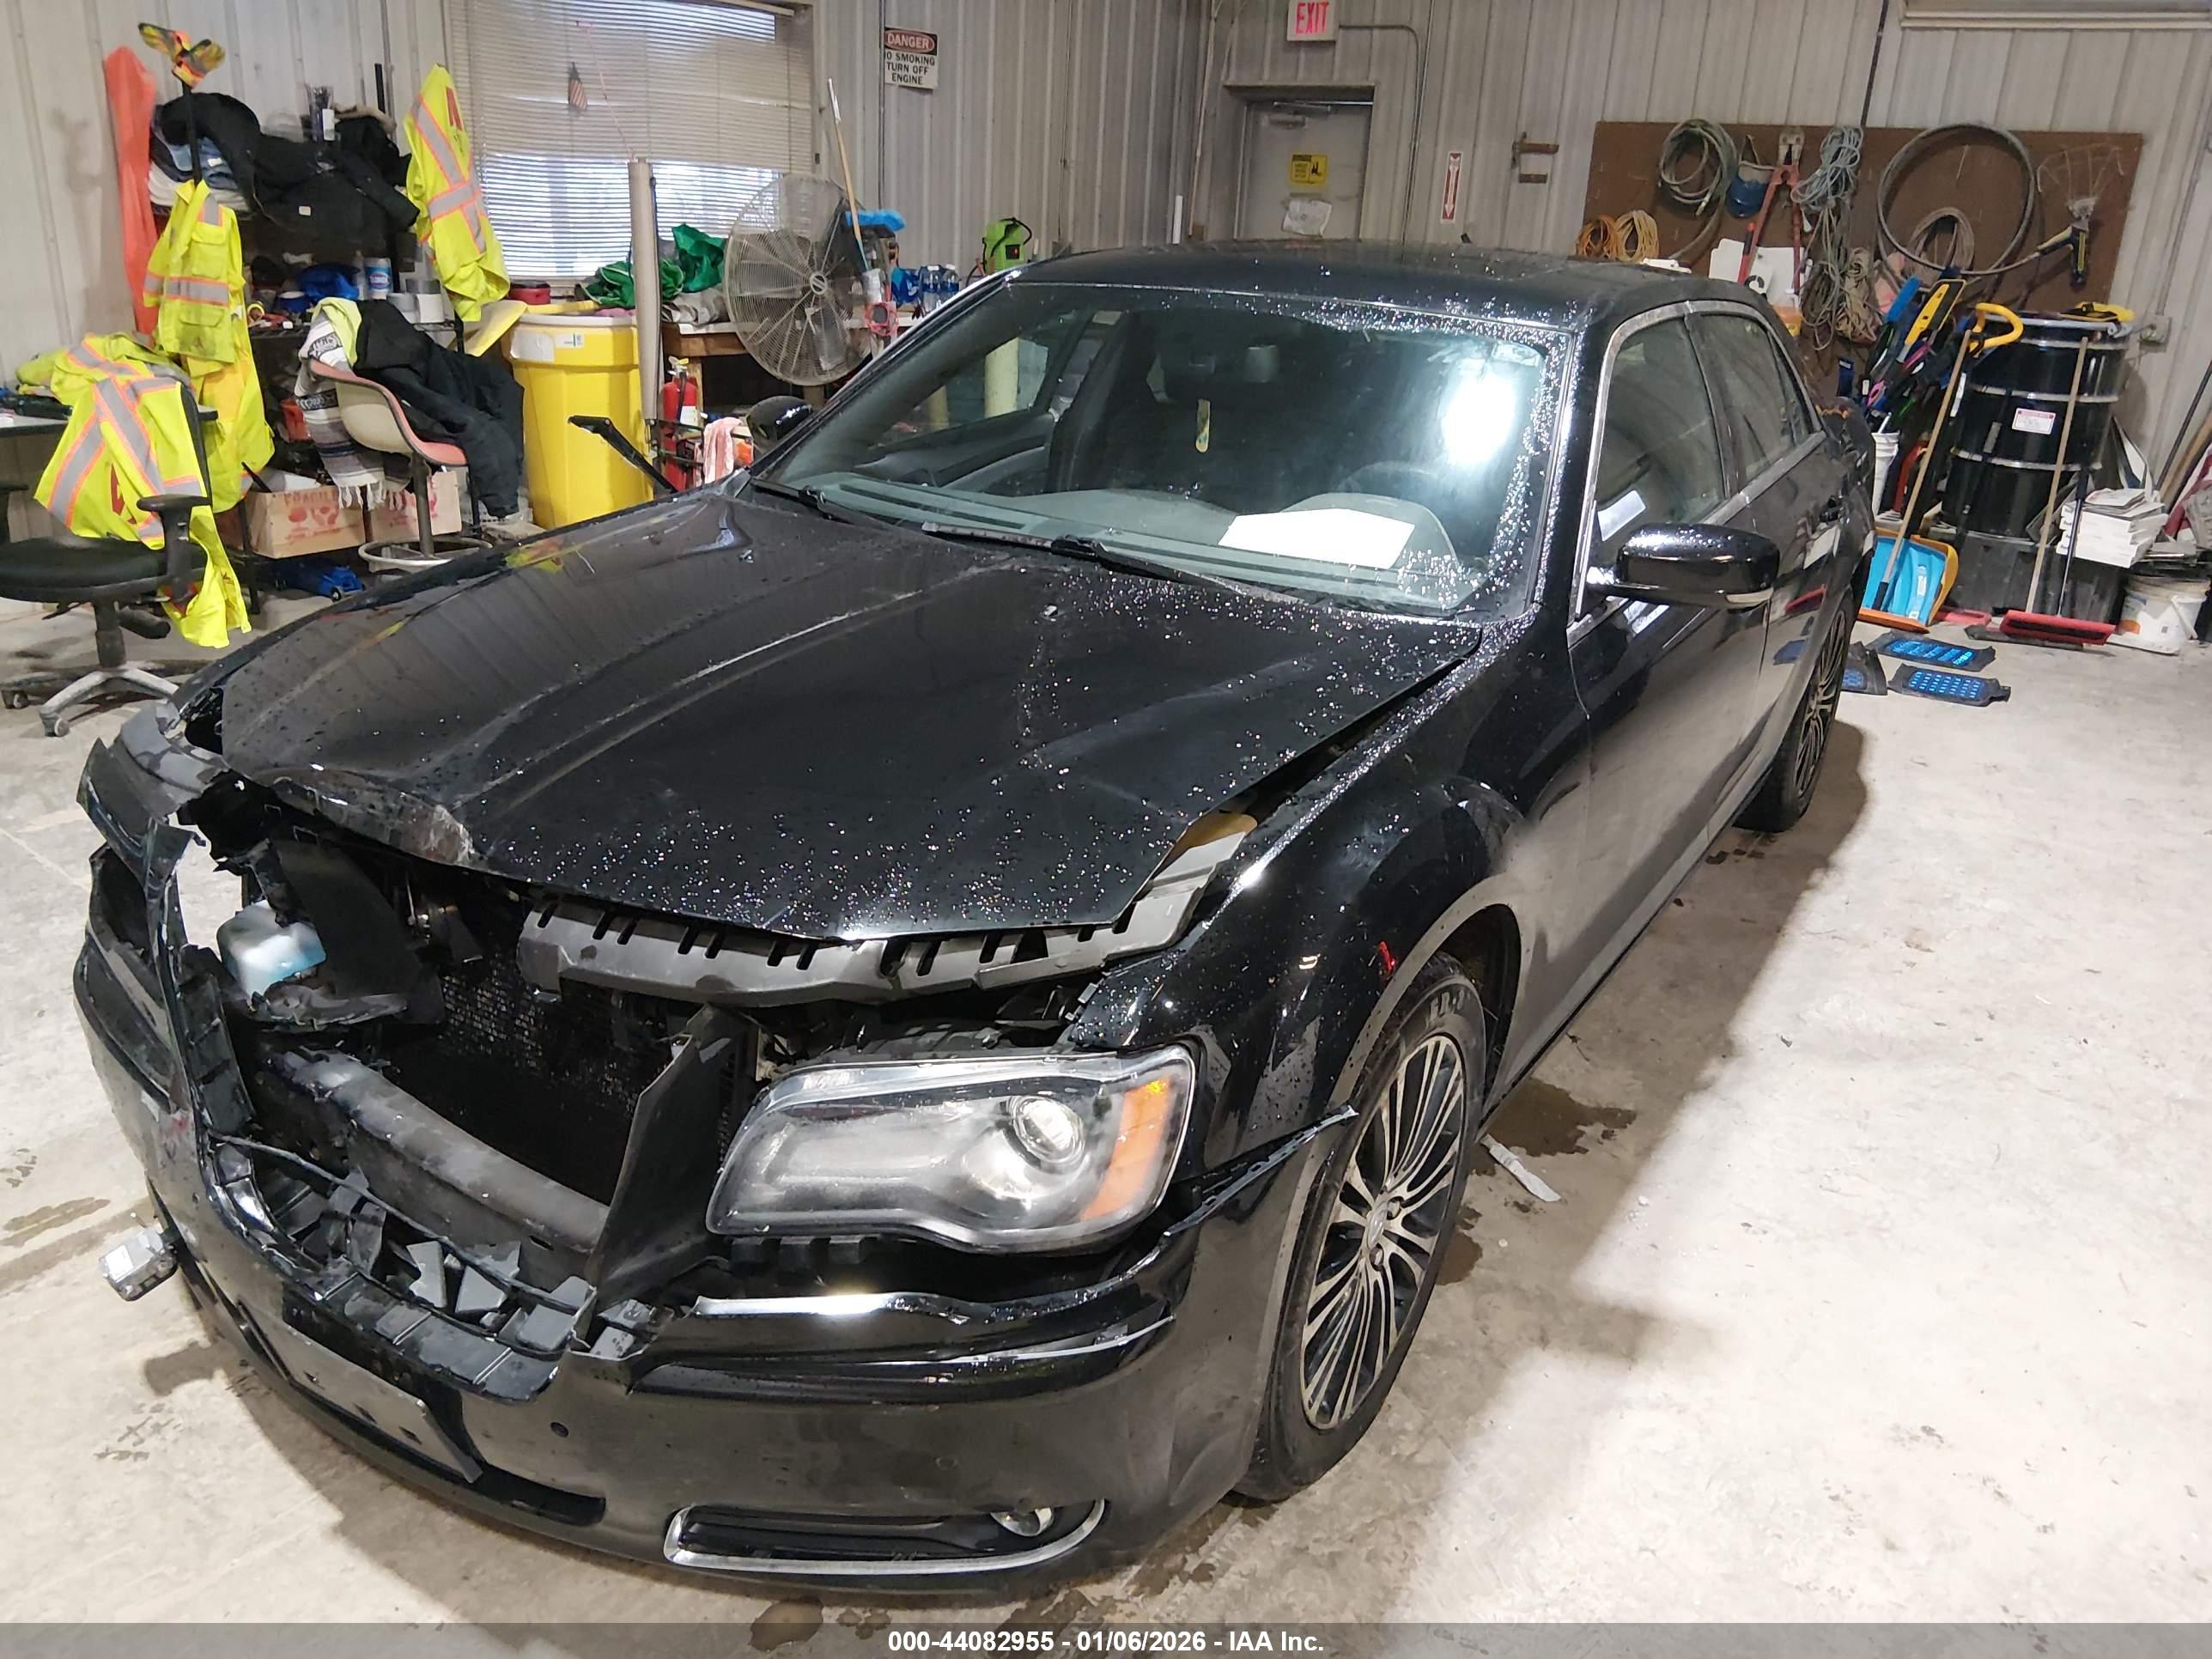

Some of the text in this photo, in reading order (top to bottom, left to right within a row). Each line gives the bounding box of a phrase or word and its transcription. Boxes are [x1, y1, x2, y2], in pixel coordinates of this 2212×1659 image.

[1296, 2, 1329, 34] EXIT
[887, 33, 930, 49] DANGER
[896, 52, 935, 66] SMOKING
[886, 62, 928, 75] TURN OFF
[891, 72, 924, 84] ENGINE
